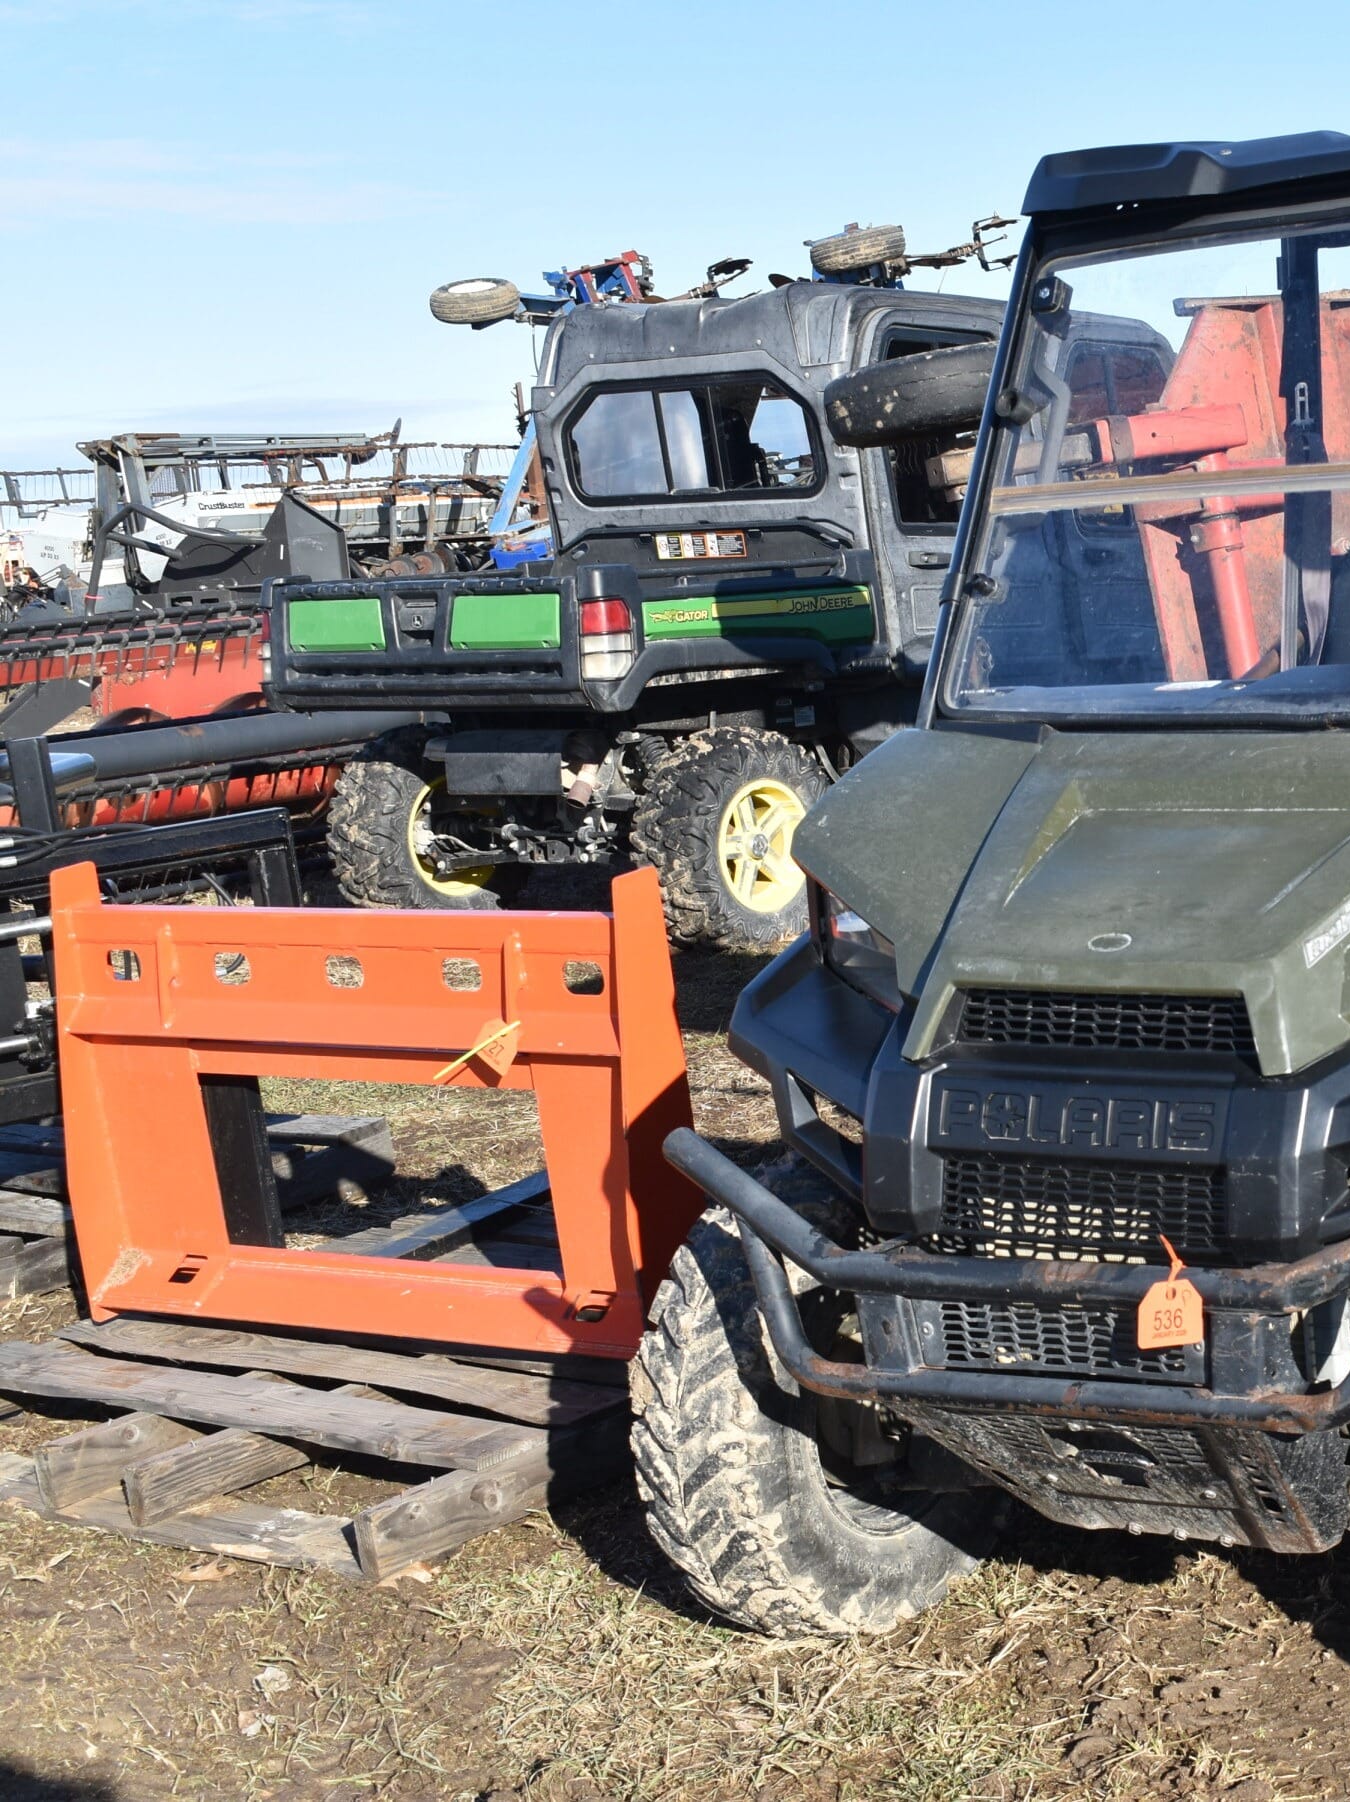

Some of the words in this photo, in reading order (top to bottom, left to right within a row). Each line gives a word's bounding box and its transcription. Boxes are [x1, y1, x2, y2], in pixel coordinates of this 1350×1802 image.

[198, 502, 245, 511] CrustBuster
[790, 599, 818, 613] JOHN
[820, 596, 854, 609] DEERE
[675, 610, 709, 623] GATOR
[939, 1088, 1215, 1151] POLARIS
[1153, 1308, 1184, 1332] 536
